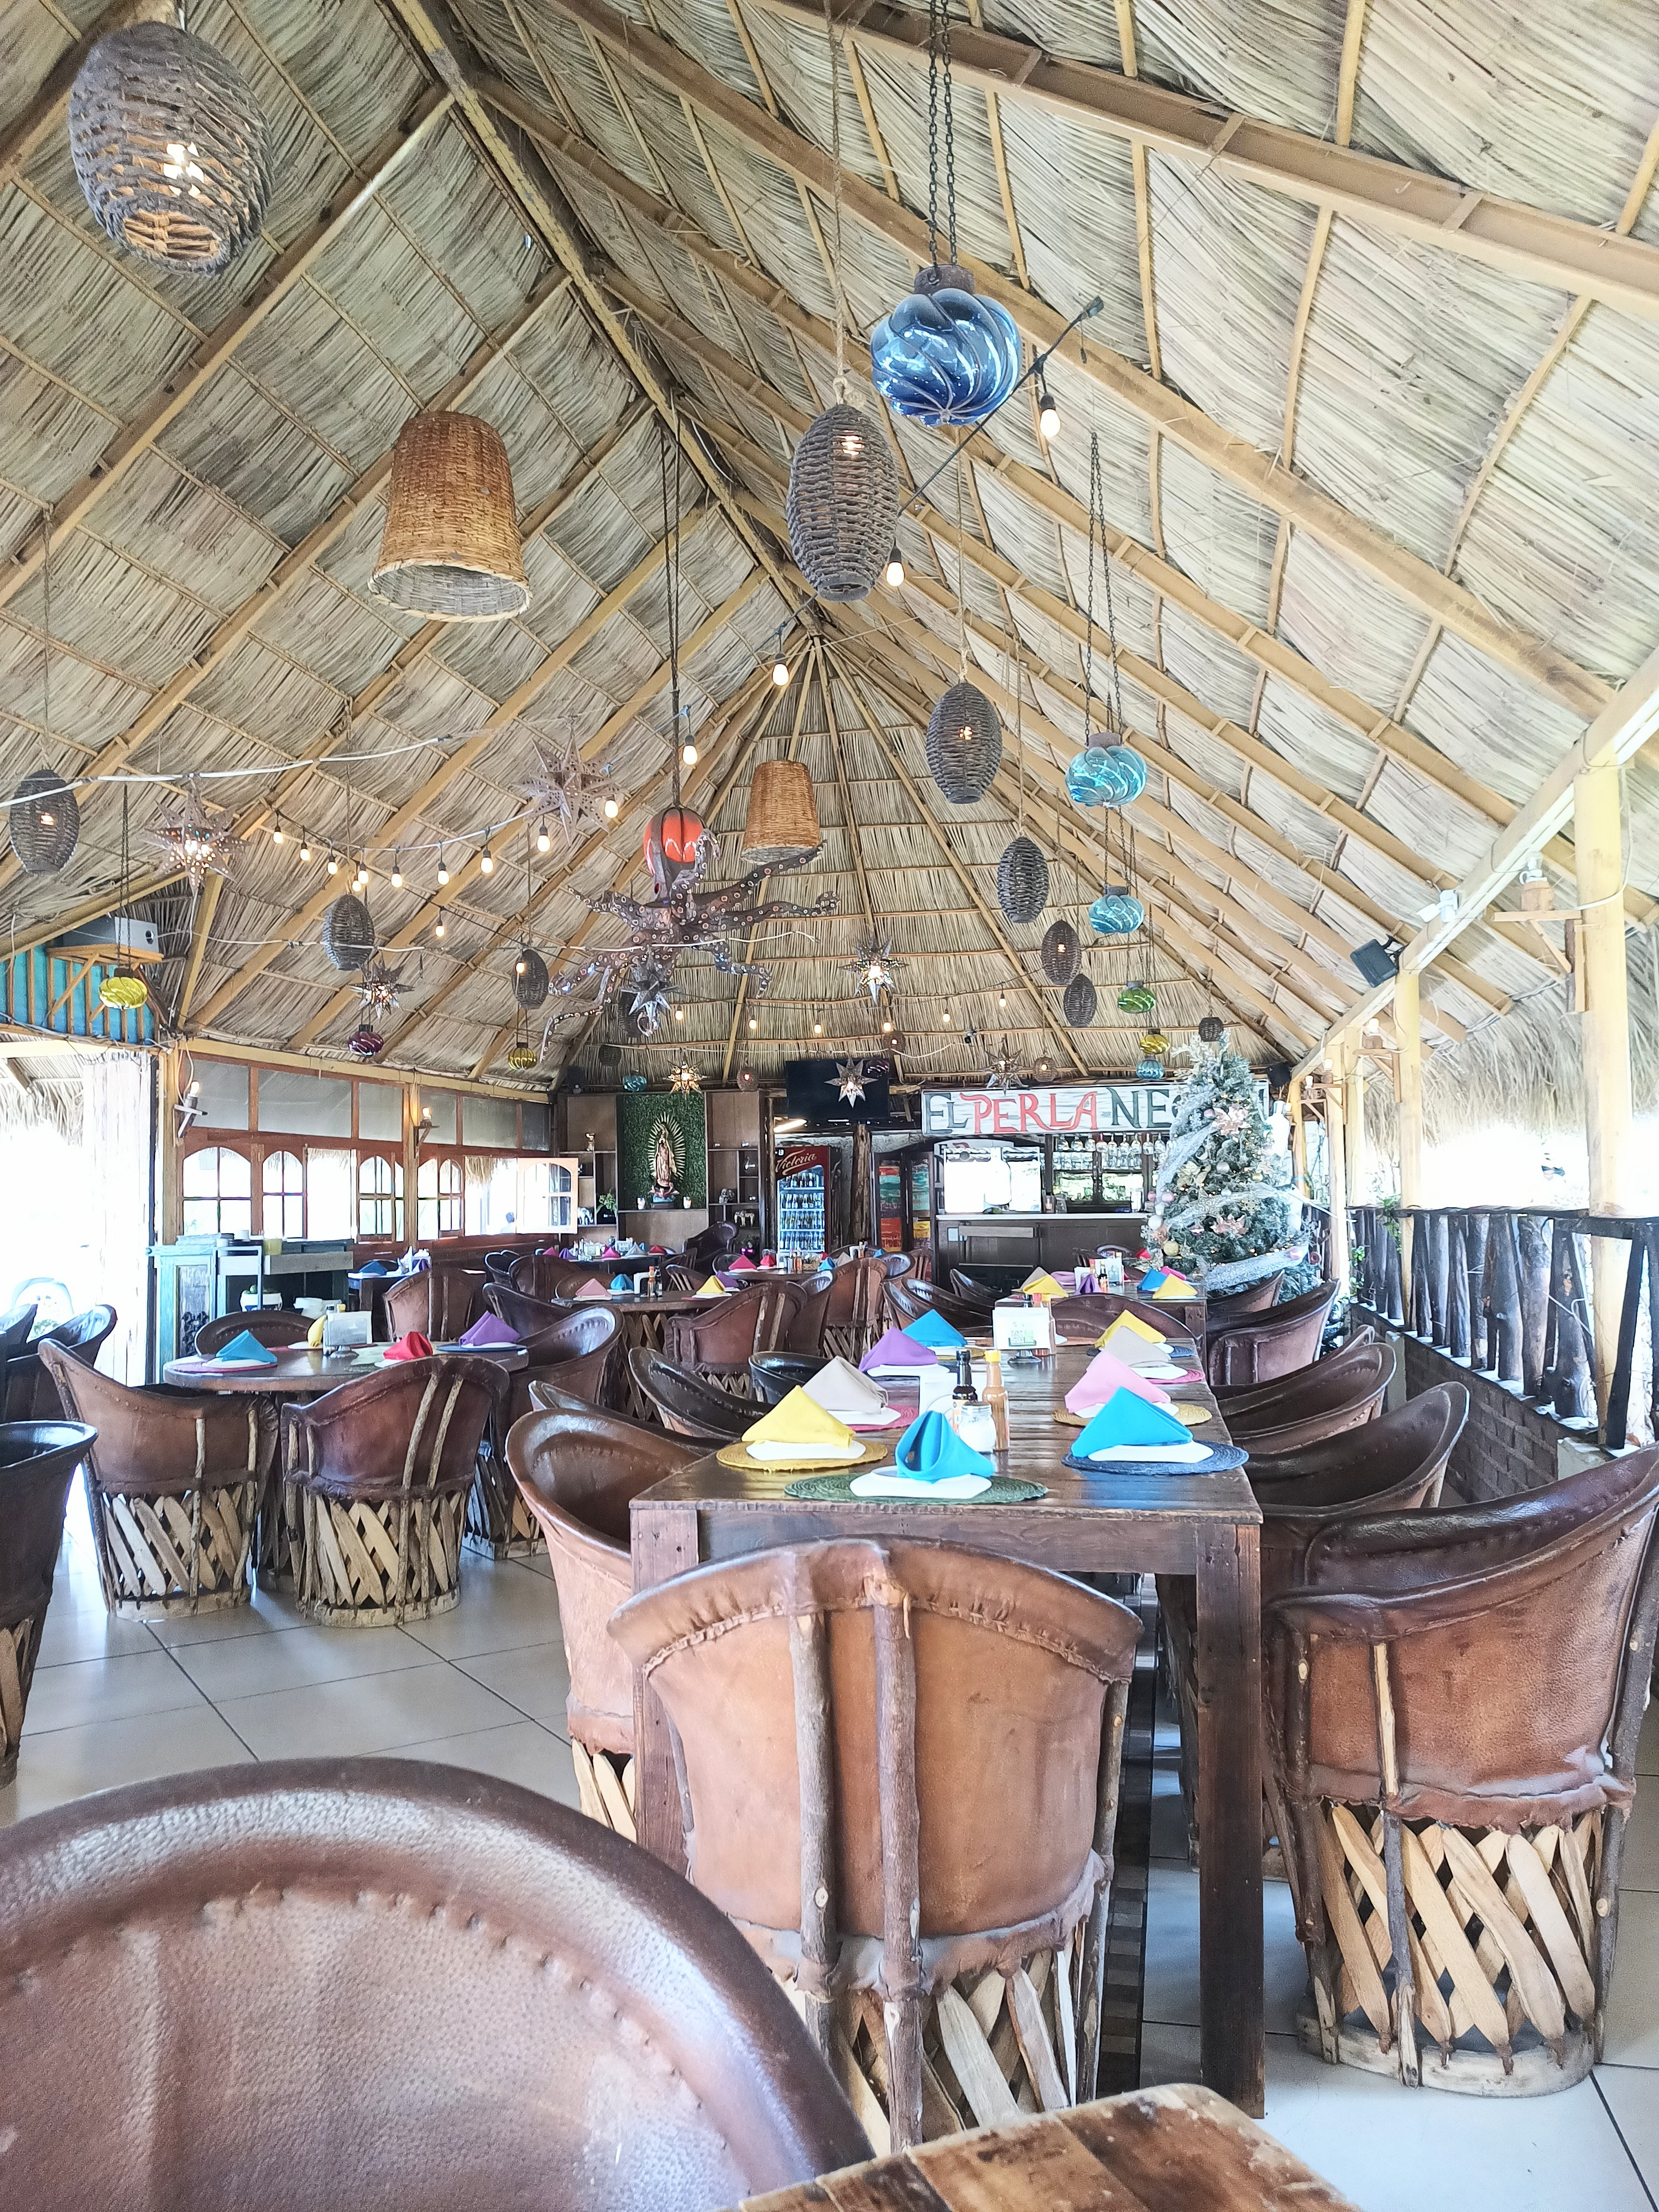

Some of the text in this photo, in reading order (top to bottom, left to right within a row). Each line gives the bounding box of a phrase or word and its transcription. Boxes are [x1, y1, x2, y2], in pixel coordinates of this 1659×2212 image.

[924, 1087, 1181, 1134] EL PERLA NE
[775, 1149, 817, 1175] Victoria
